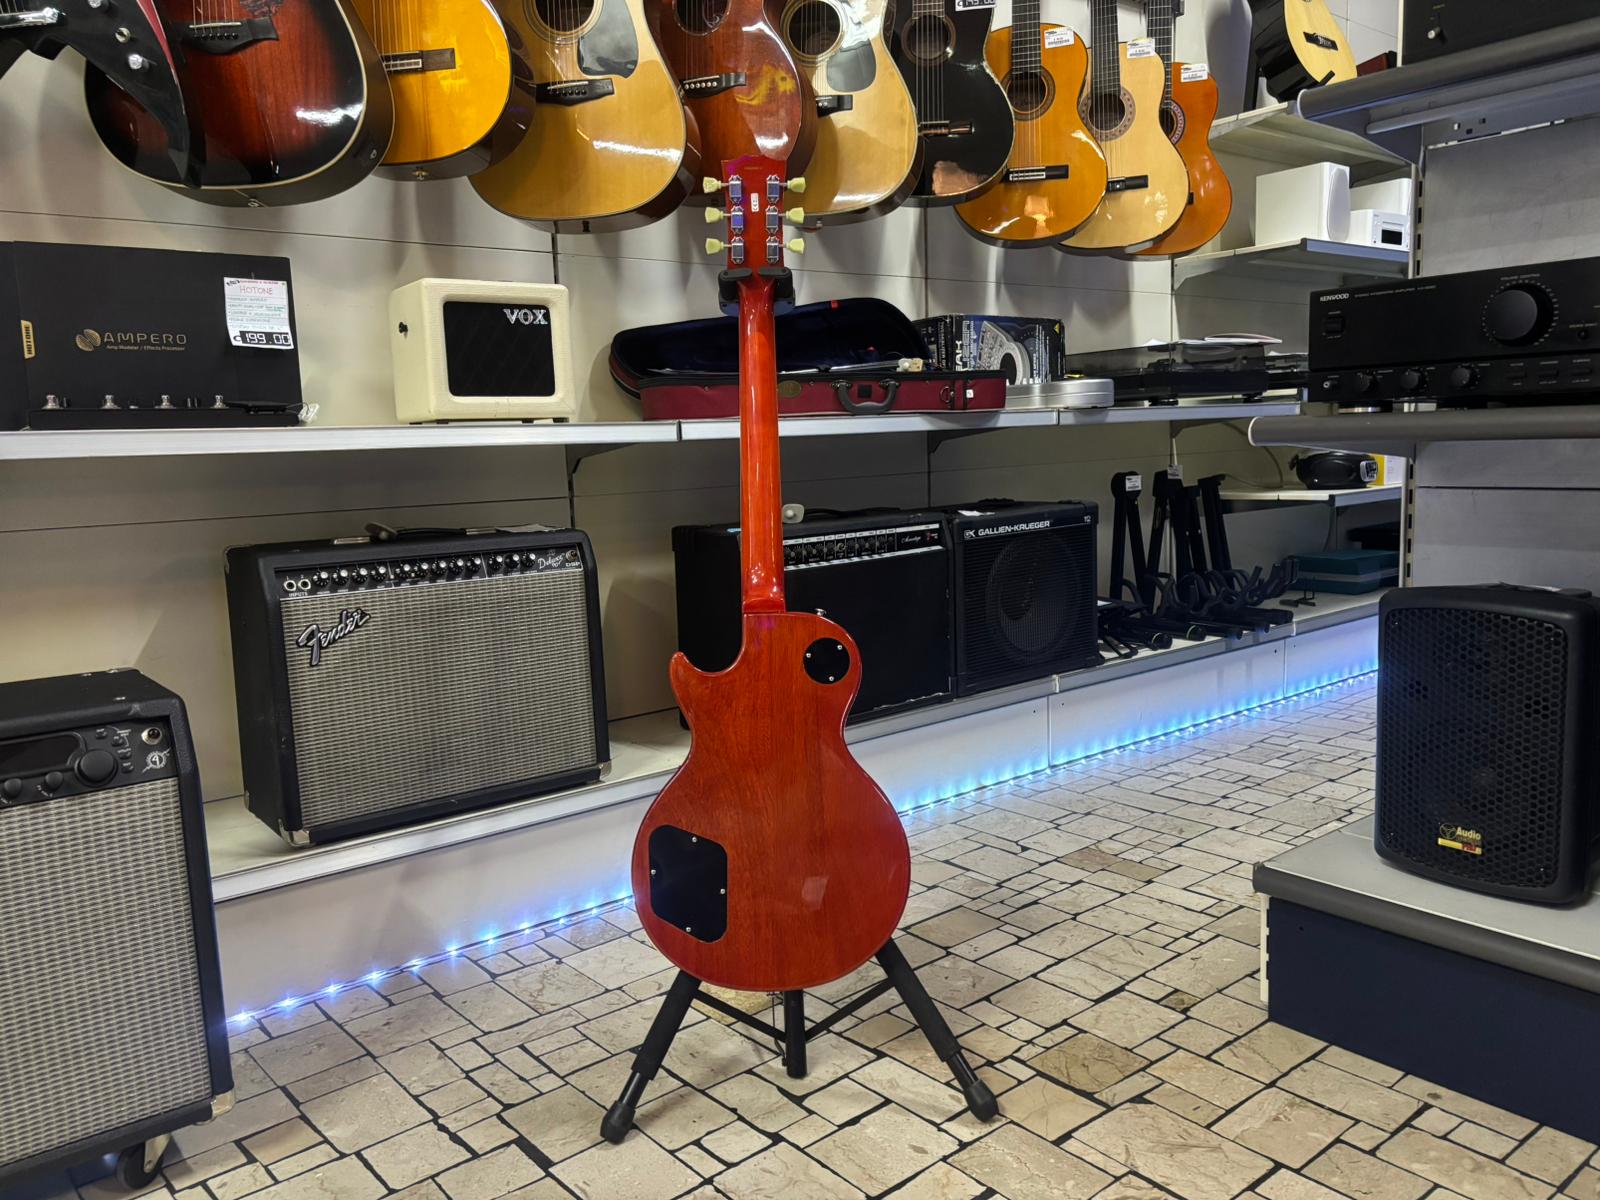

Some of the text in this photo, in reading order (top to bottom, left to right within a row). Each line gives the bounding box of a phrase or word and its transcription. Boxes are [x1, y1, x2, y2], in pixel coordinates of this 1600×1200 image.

[1319, 292, 1350, 302] KENWOOD
[503, 309, 549, 324] VOX
[104, 332, 187, 344] AMPERO
[245, 333, 291, 345] 199.00
[978, 520, 1050, 536] GALLIEN-KRUEGER
[297, 609, 371, 666] Fender
[1455, 826, 1481, 840] Audio
